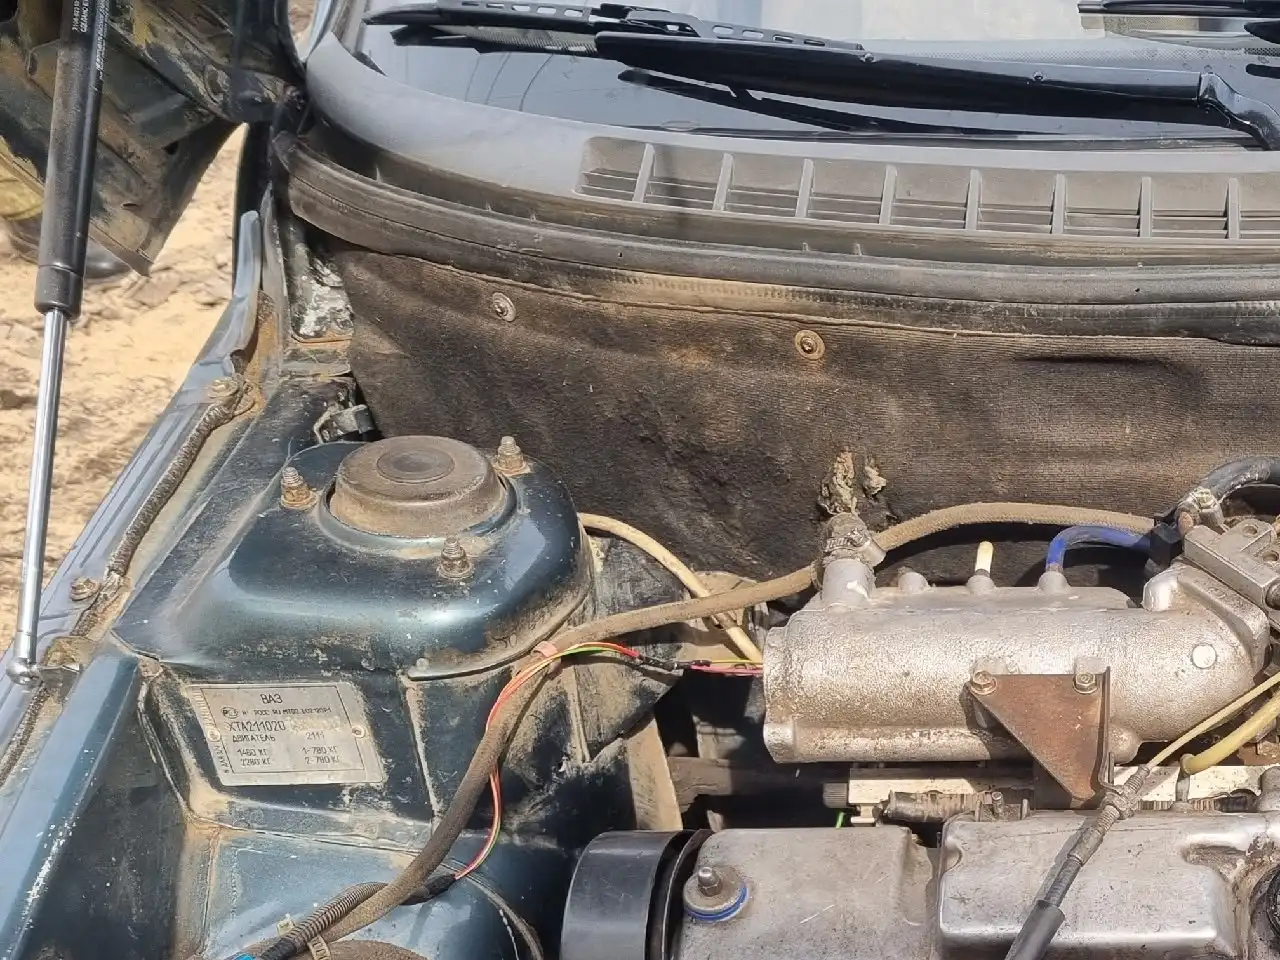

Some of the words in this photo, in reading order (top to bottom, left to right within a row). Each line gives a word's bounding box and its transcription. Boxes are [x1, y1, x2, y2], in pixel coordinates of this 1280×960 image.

[260, 694, 283, 704] ВАЗ
[232, 734, 276, 743] ДВИГАТЕЛЬ
[306, 731, 325, 740] 2111
